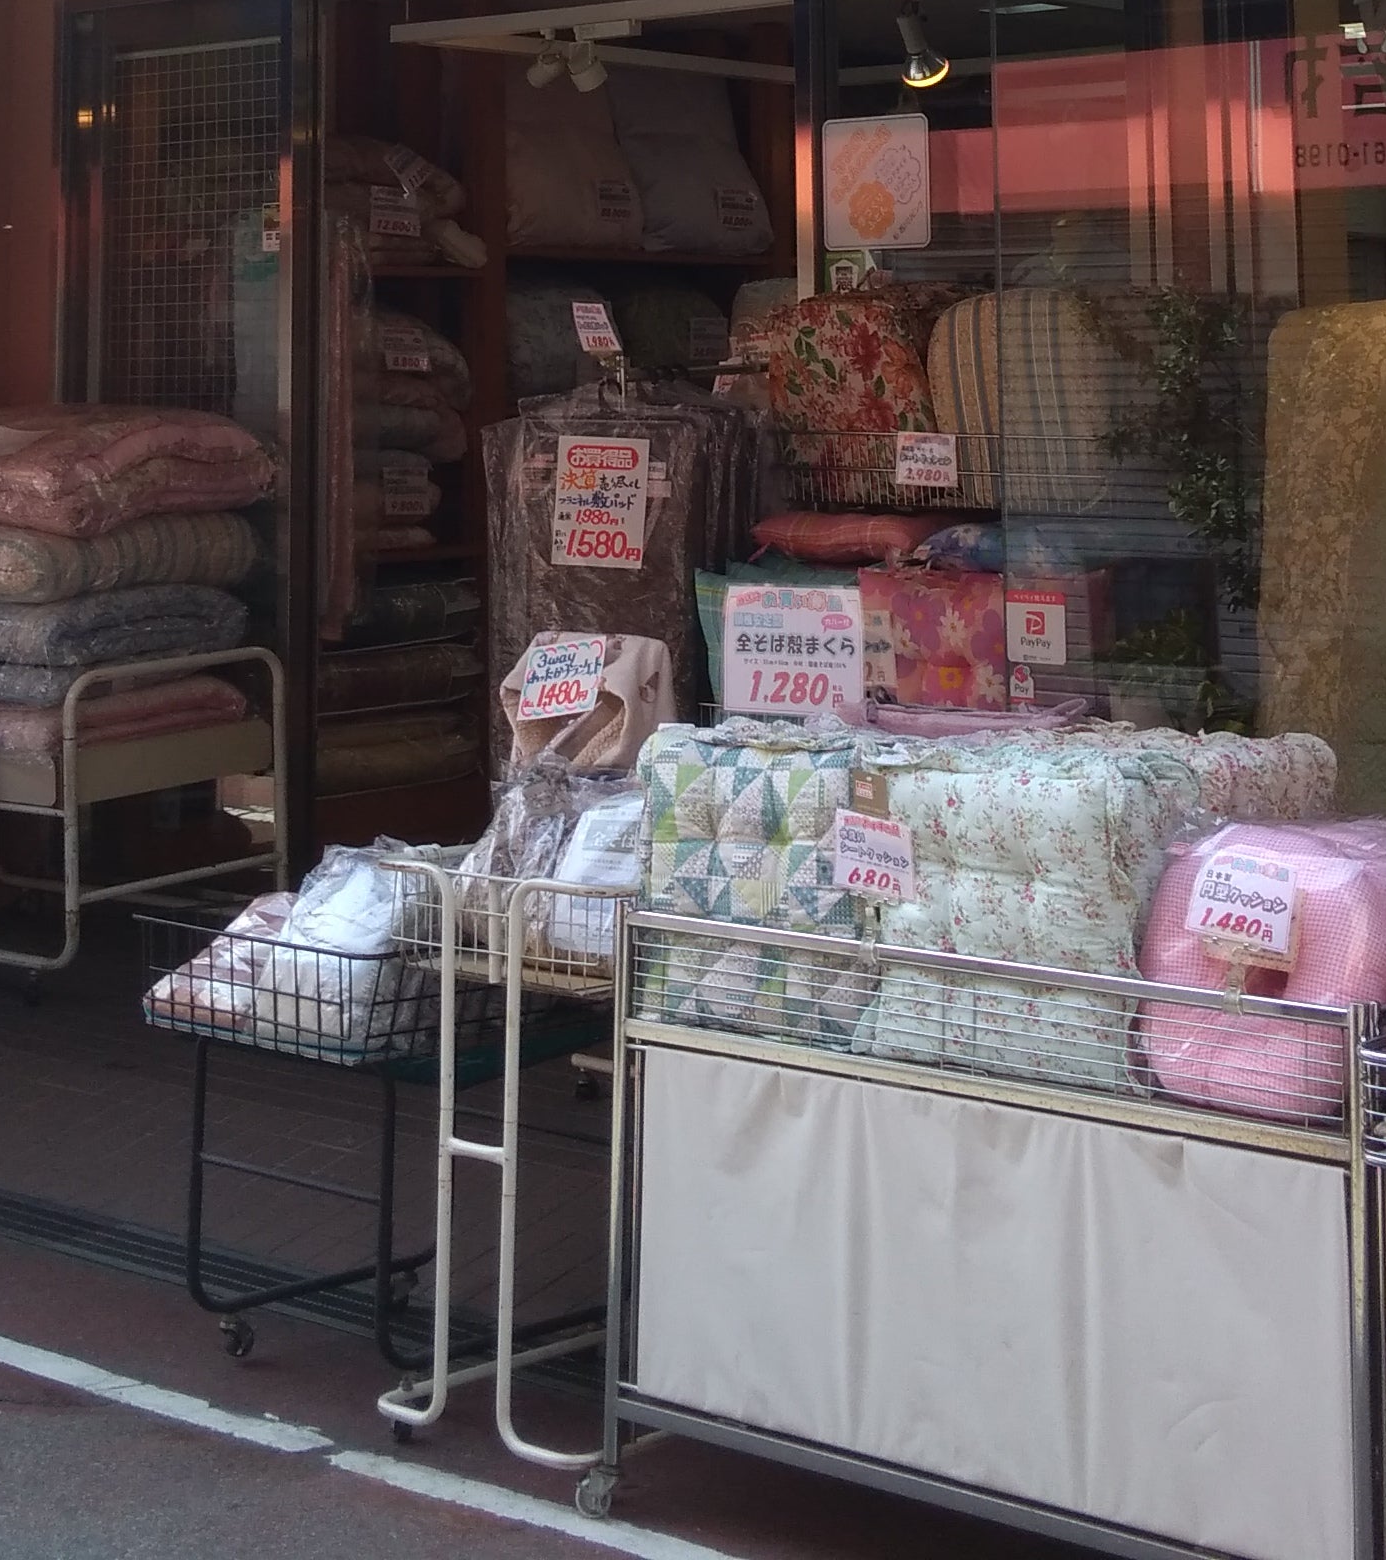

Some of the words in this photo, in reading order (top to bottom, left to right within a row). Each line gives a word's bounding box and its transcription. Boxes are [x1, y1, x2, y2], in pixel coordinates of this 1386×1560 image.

[735, 633, 856, 657] 全そば殻まくら
[1020, 636, 1052, 650] PayPay
[1014, 683, 1030, 695] Pay
[1205, 868, 1233, 882] 日本製
